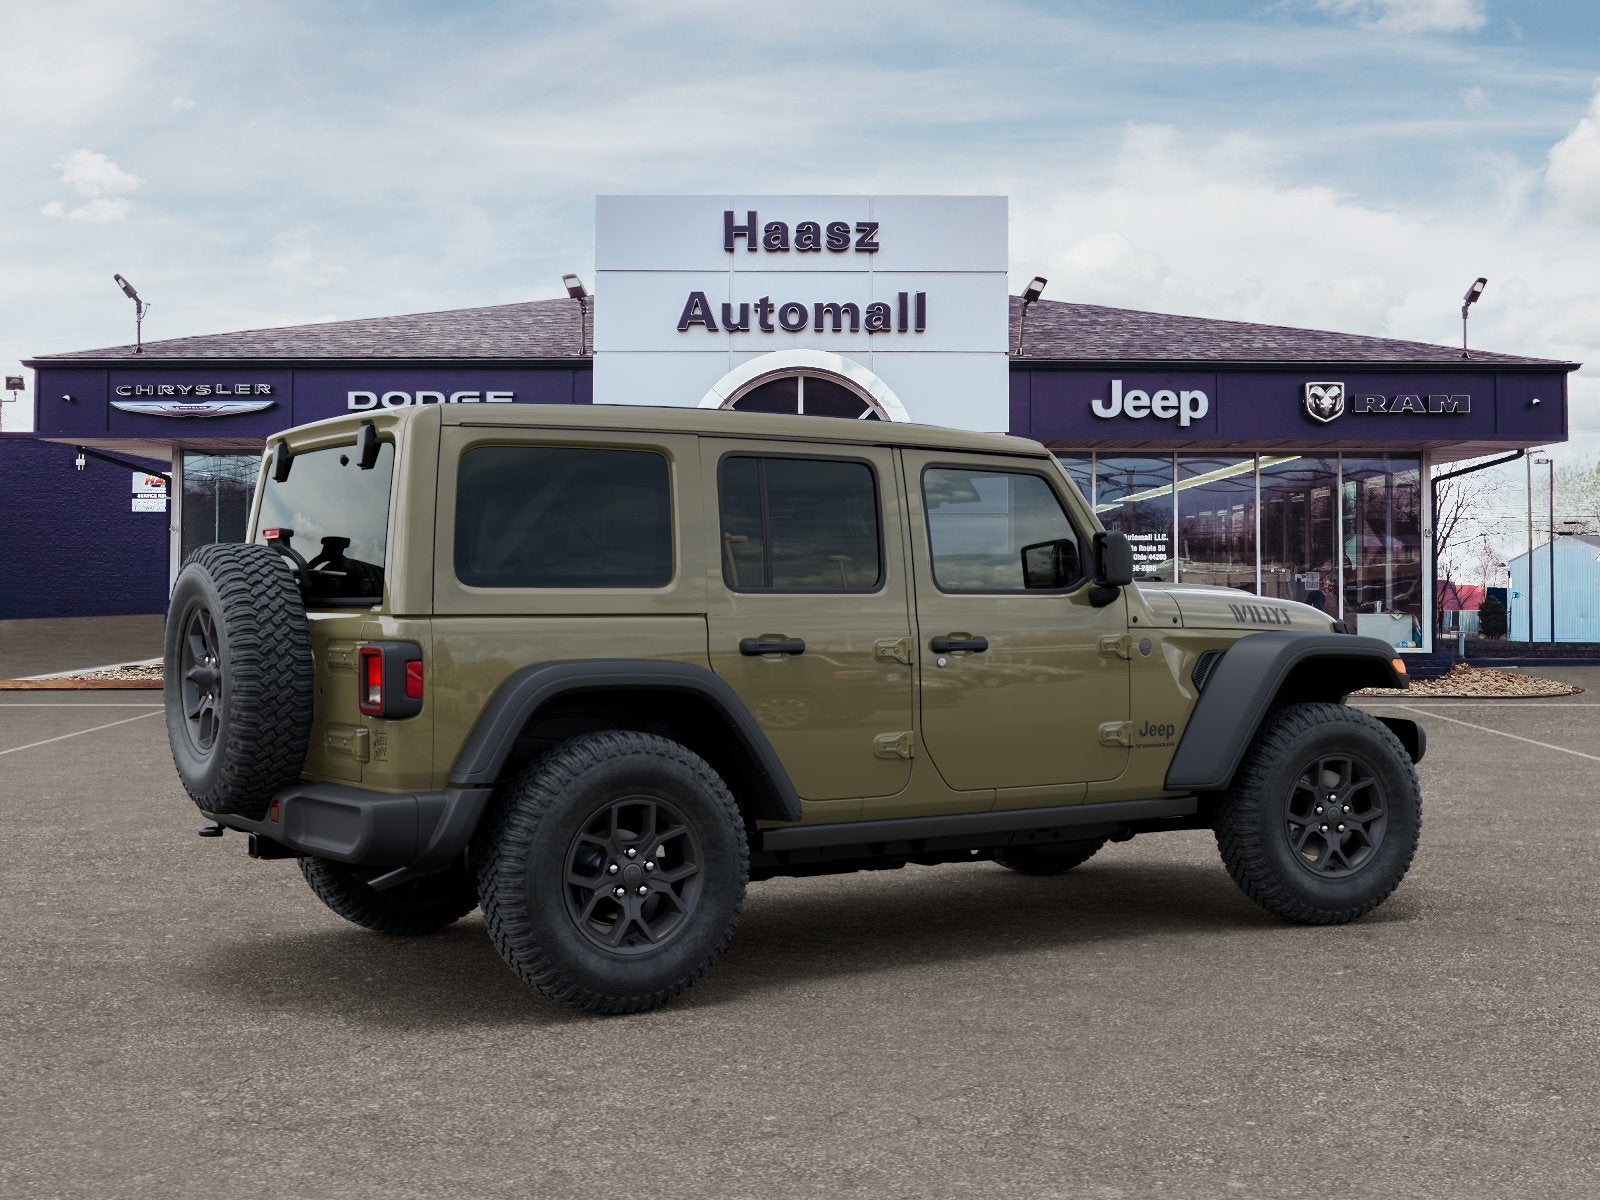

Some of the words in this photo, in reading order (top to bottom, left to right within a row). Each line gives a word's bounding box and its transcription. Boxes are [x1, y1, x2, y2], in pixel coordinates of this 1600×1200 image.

[723, 210, 880, 252] Haasz
[676, 290, 928, 333] Automall
[115, 384, 271, 396] CHRYSLER
[347, 391, 514, 409] DODGE
[1091, 379, 1209, 427] Jeep
[1354, 394, 1471, 413] RAM
[1132, 553, 1147, 561] Ohio
[1227, 603, 1292, 625] WILLYS
[1139, 720, 1175, 739] Jeep
